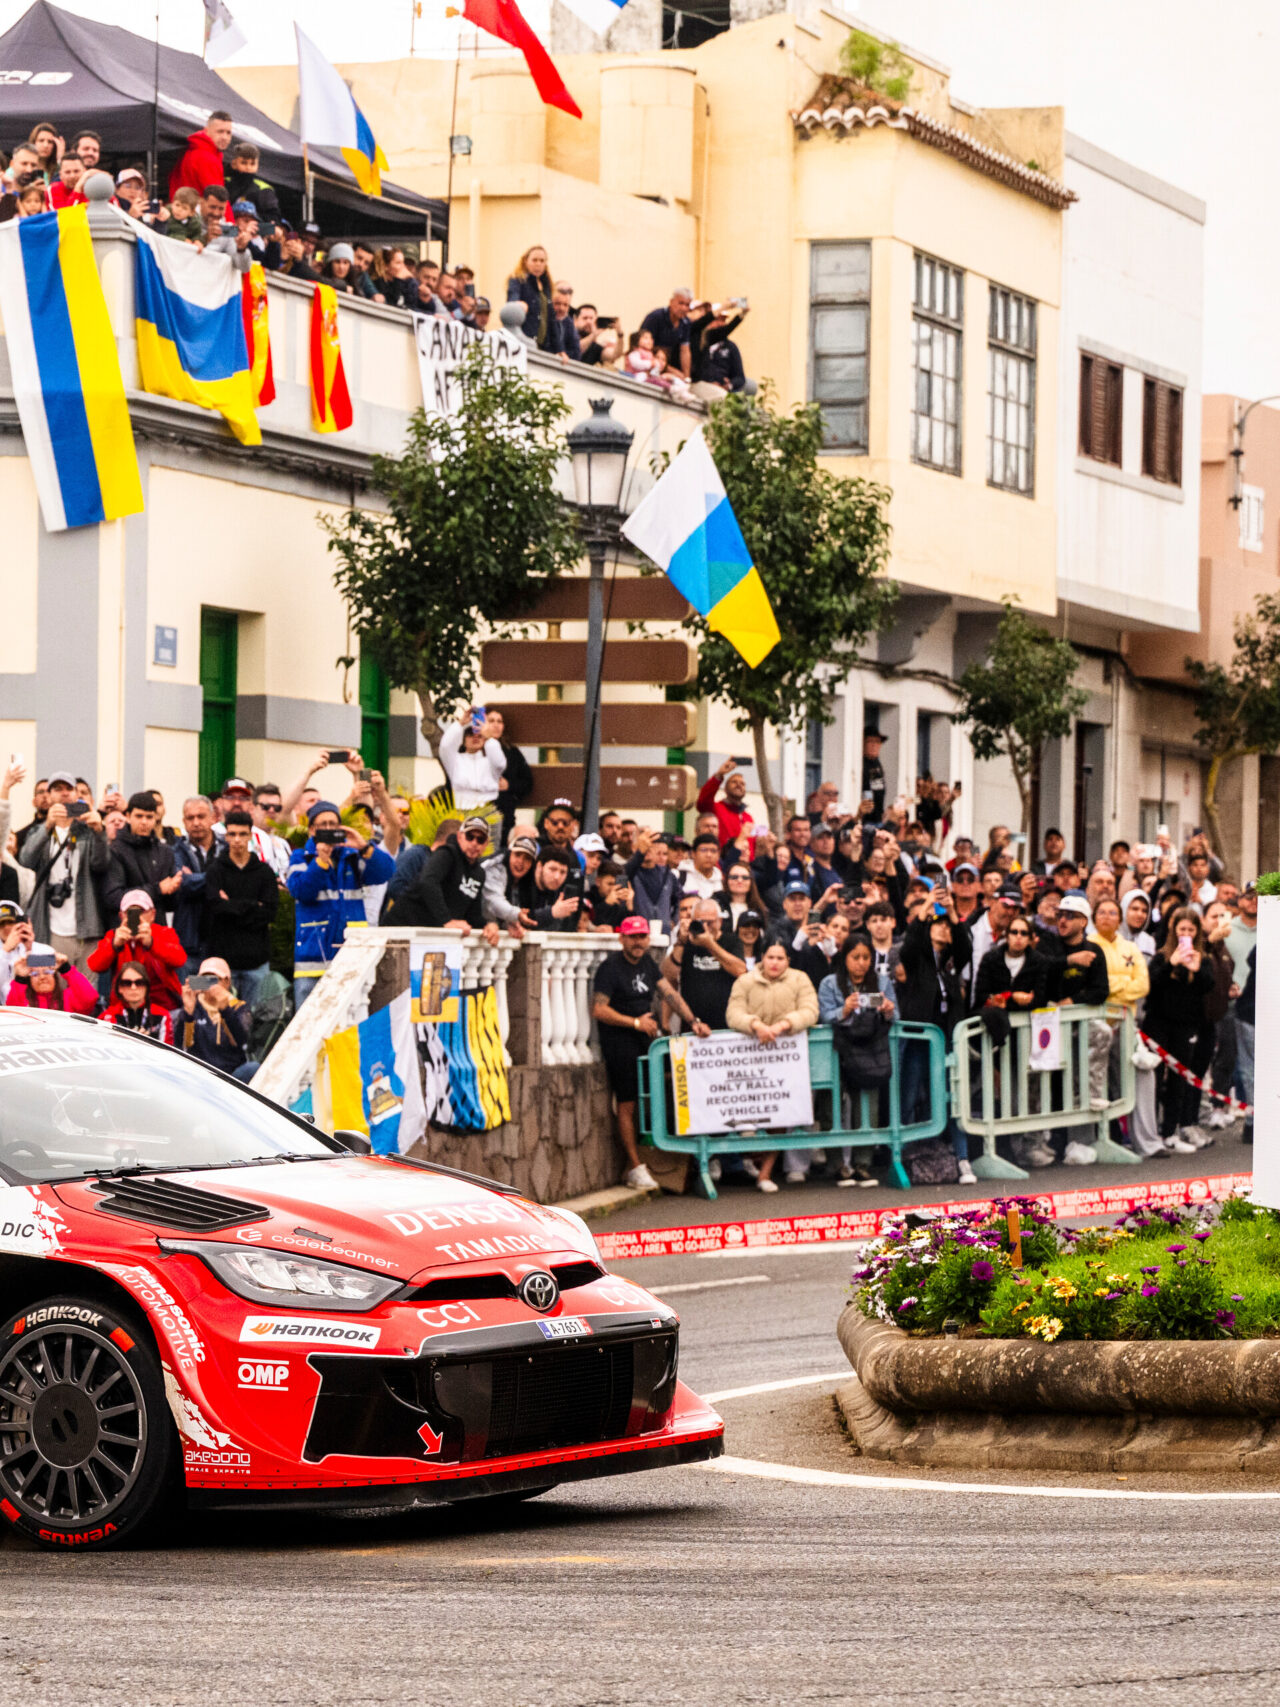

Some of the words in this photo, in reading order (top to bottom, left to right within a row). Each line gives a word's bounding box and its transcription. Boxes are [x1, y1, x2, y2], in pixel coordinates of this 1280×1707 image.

[690, 1053, 800, 1070] RECONOCIMIENTO
[727, 1069, 765, 1079] RALLY
[676, 1063, 689, 1108] AVISO
[709, 1082, 742, 1093] ONLY
[746, 1079, 784, 1090] RALLY
[706, 1091, 790, 1106] RECOGNITION
[720, 1105, 779, 1117] VEHICLES
[1102, 1187, 1147, 1200] PROHIBIDO
[1150, 1182, 1186, 1196] PUBLICO
[1078, 1203, 1106, 1215] NO-GO
[1107, 1201, 1129, 1213] AREA
[384, 1204, 518, 1237] DENSO
[793, 1217, 838, 1230] PROHIBIDO
[841, 1213, 876, 1226] PUBLICO
[640, 1230, 685, 1243] PROHIBIDO
[687, 1226, 722, 1239] PUBLICO
[769, 1232, 796, 1244] NO-GO
[797, 1230, 820, 1241] AREA
[824, 1228, 837, 1239] NO
[838, 1225, 875, 1238] GO-AREA
[271, 1235, 396, 1268] codebeamer
[435, 1234, 552, 1262] TAMADIC
[616, 1245, 643, 1257] NO-GO
[644, 1243, 666, 1255] AREA
[671, 1241, 684, 1252] NO
[685, 1239, 722, 1251] GO-AREA
[112, 1268, 194, 1369] AUTOMOTIVE
[128, 1265, 206, 1363] Panasonic
[550, 1321, 583, 1335] A-7651
[238, 1364, 289, 1385] OMP
[185, 1450, 251, 1463] akebono
